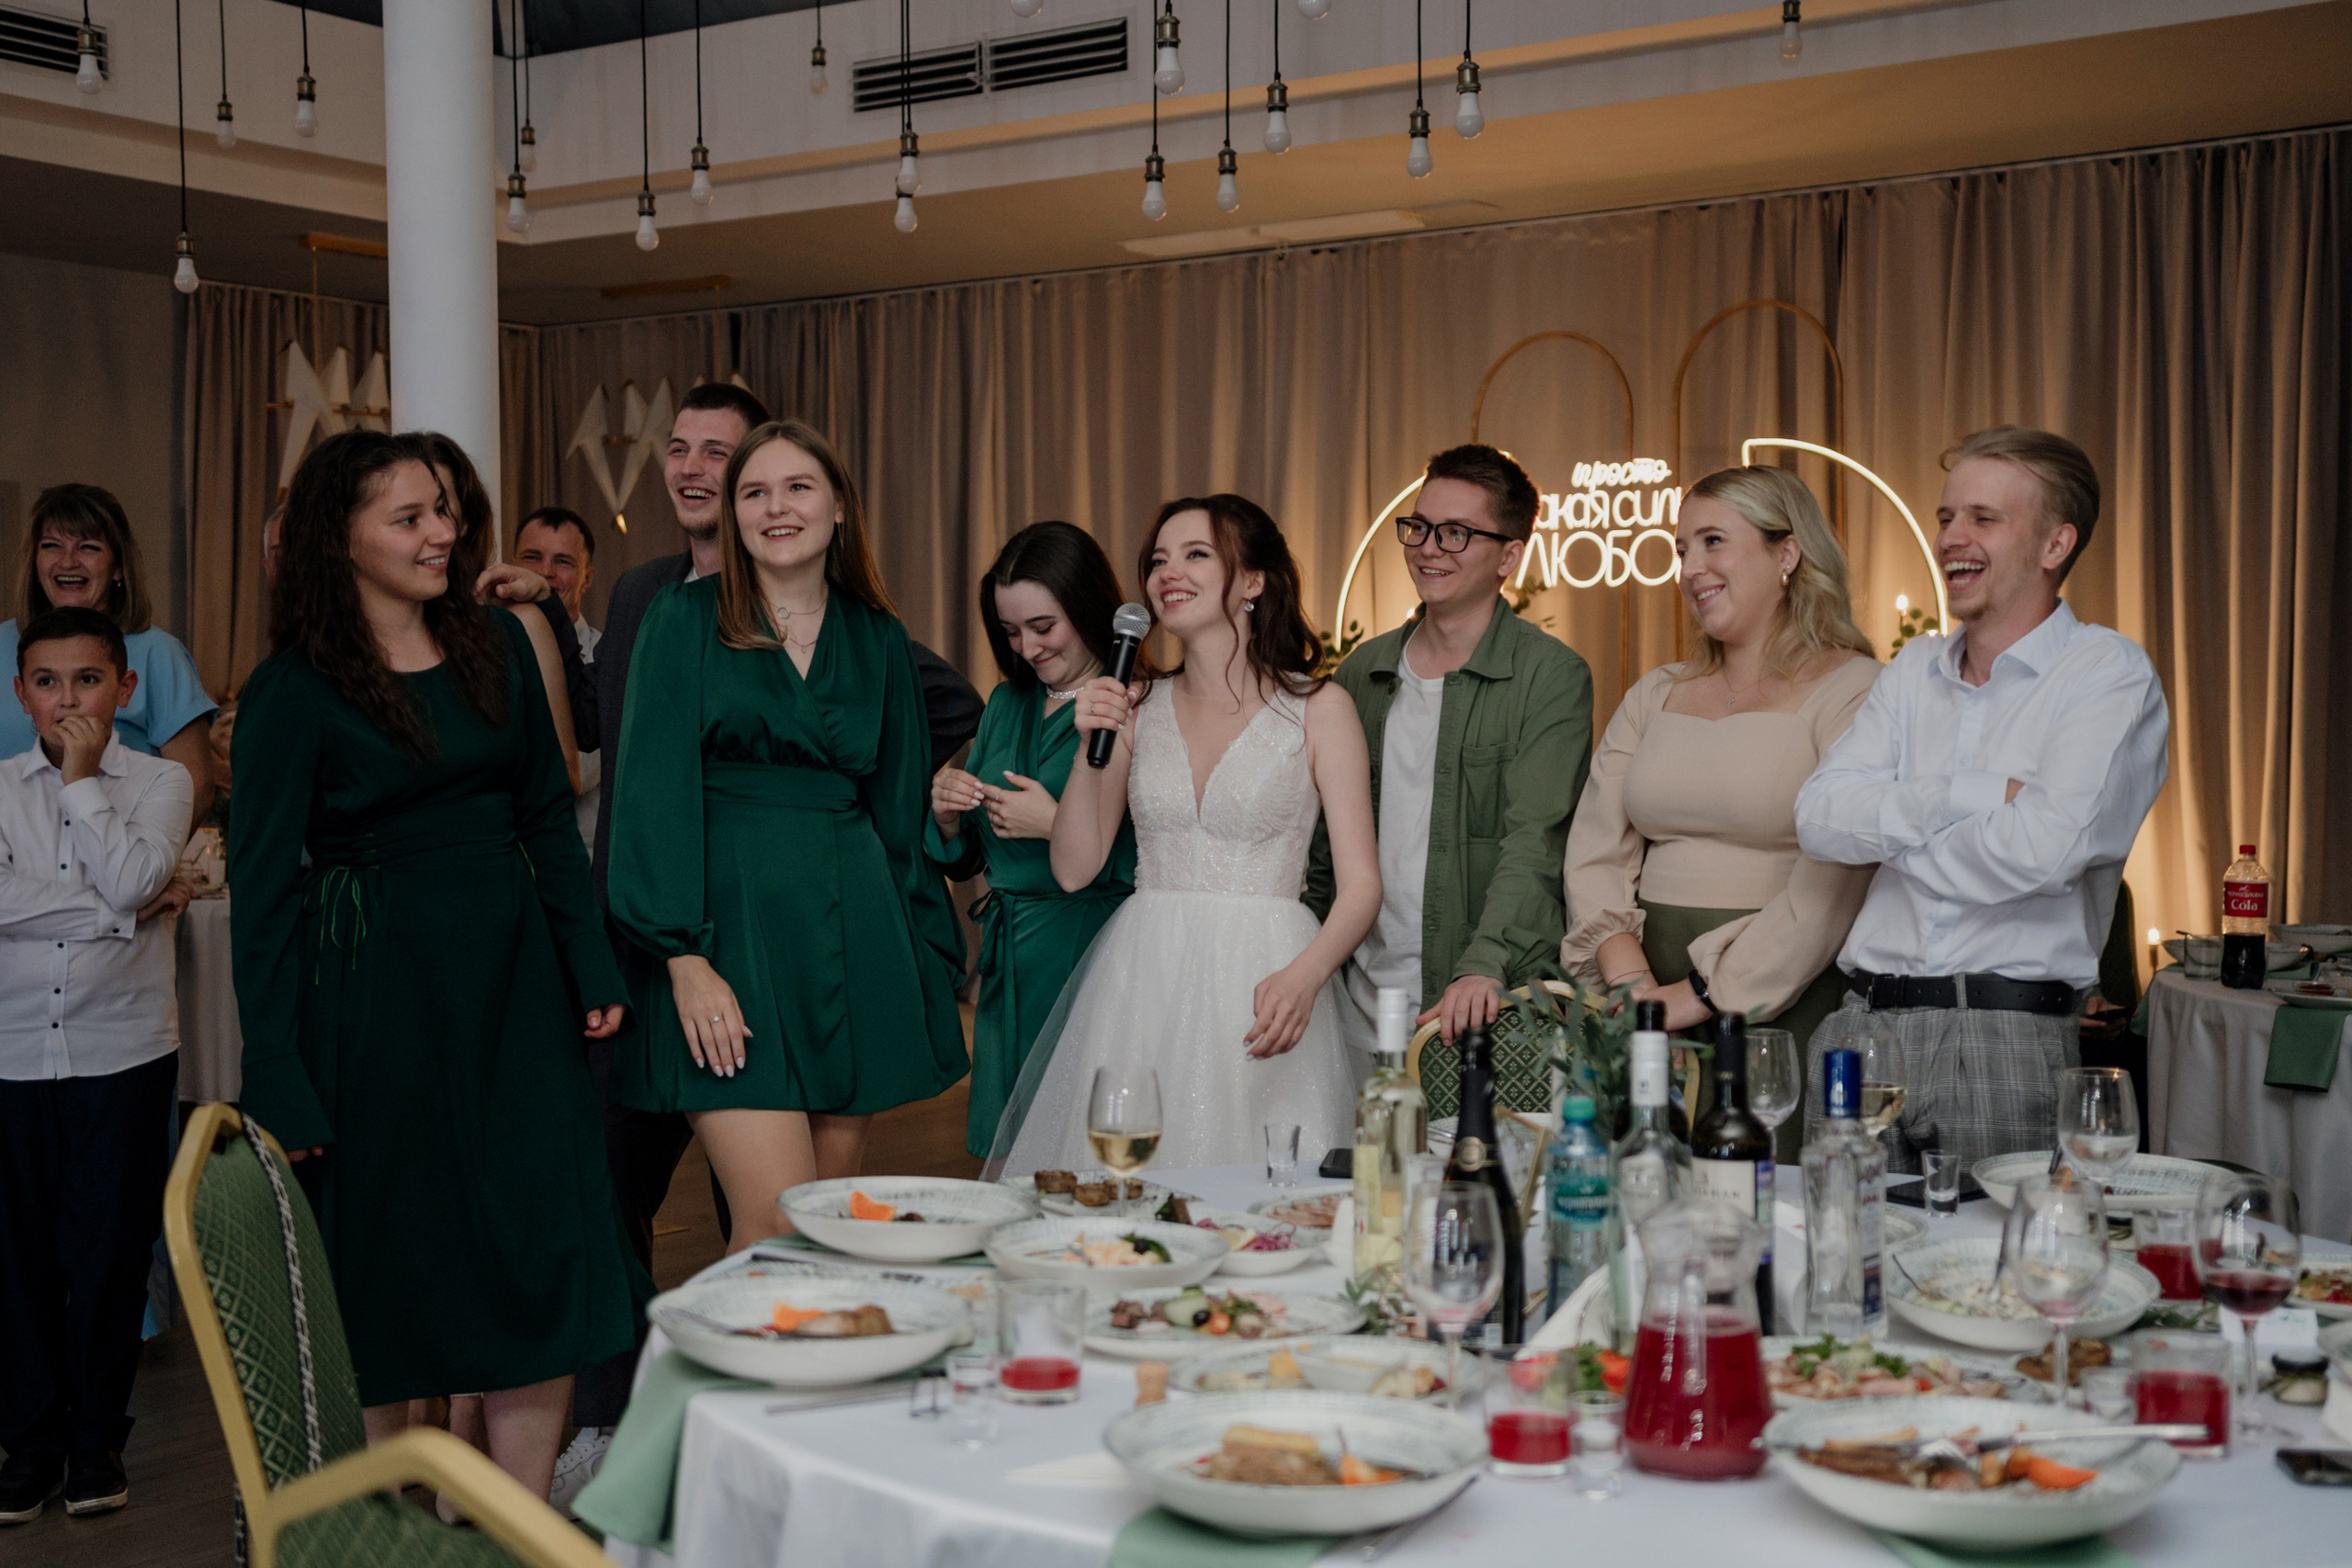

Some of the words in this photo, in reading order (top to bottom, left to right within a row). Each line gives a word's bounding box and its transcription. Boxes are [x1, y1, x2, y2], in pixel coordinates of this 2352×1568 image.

[1533, 489, 1610, 530] акая
[1515, 528, 1682, 589] ЛЮБО
[2231, 898, 2258, 911] Cola
